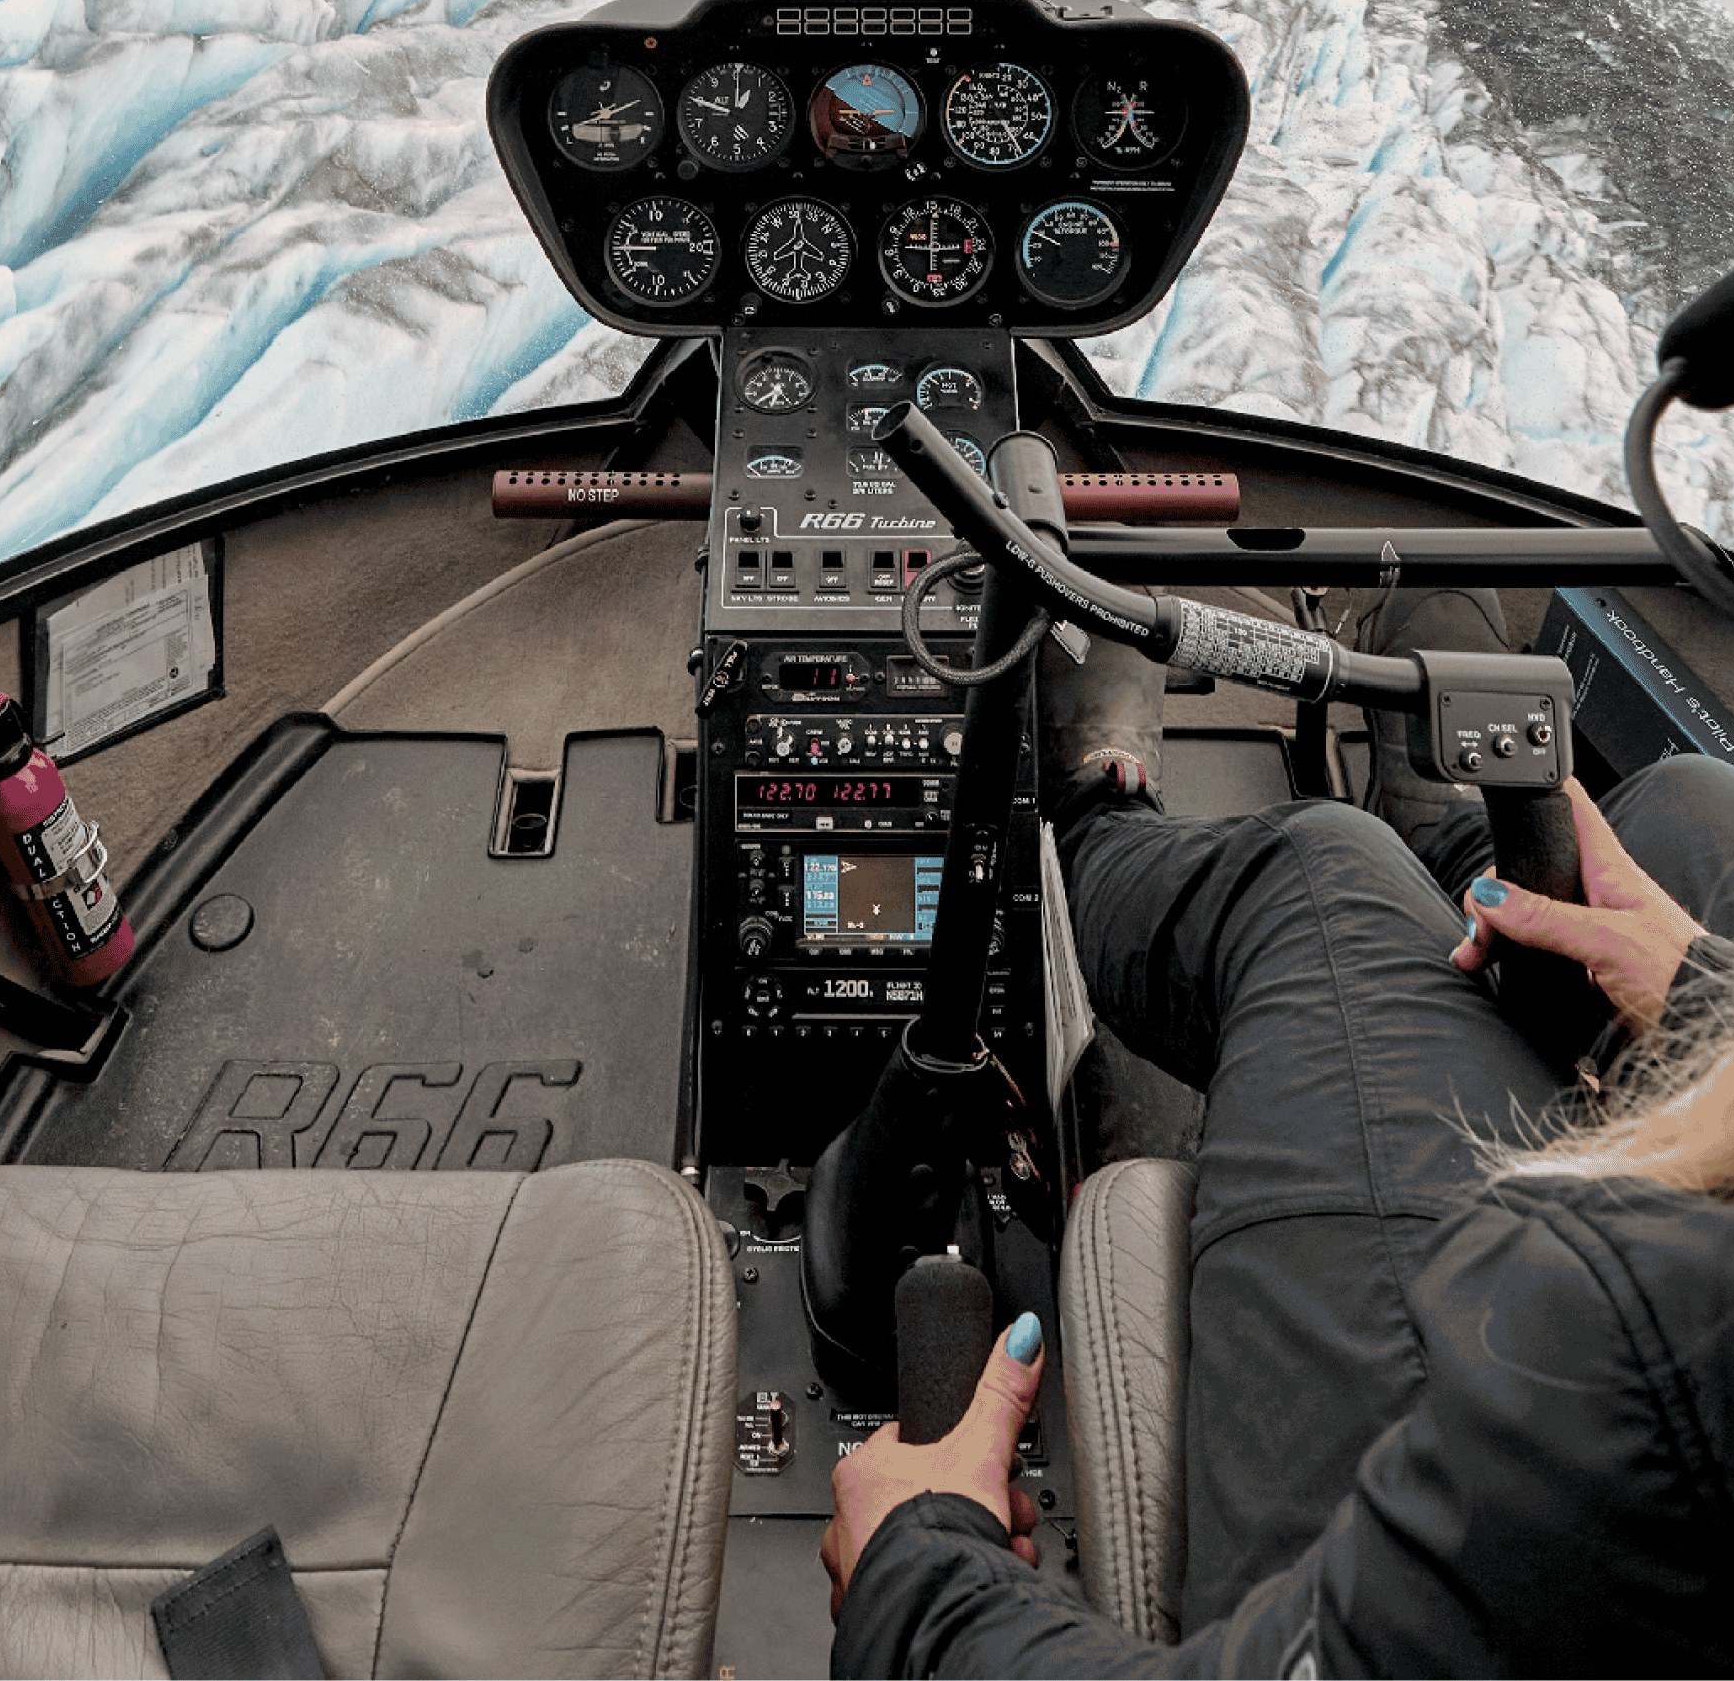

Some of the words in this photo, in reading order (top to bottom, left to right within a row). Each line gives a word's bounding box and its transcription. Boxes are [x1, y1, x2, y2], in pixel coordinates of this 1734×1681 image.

[710, 77, 719, 89] 9
[768, 90, 778, 103] 2
[694, 118, 704, 129] 7
[768, 120, 778, 133] 3
[710, 136, 720, 147] 6
[756, 136, 766, 147] 4
[733, 143, 742, 155] 5
[649, 210, 664, 222] 10
[568, 488, 586, 502] NO
[588, 488, 620, 503] STEP
[799, 512, 866, 530] R66
[870, 515, 936, 530] Turbine
[729, 536, 755, 544] PANEL
[1005, 540, 1036, 569] LOW-G
[1035, 565, 1089, 609] PUSHOVERS
[1089, 604, 1149, 637] PROHIBITED
[766, 595, 800, 603] STROBE
[813, 595, 850, 603] AVIONICS
[1607, 609, 1686, 694] Handbook
[783, 654, 796, 663] AIR
[798, 654, 849, 663] TEMPERATURE
[1526, 712, 1547, 722] HYD
[1487, 723, 1500, 733] CH
[1501, 723, 1518, 733] SEL
[759, 782, 817, 801] 122.70
[833, 782, 892, 801] 122.77
[22, 833, 48, 879] DUAL
[1012, 893, 1032, 902] COM
[824, 979, 868, 998] 1200
[163, 1059, 583, 1171] R66
